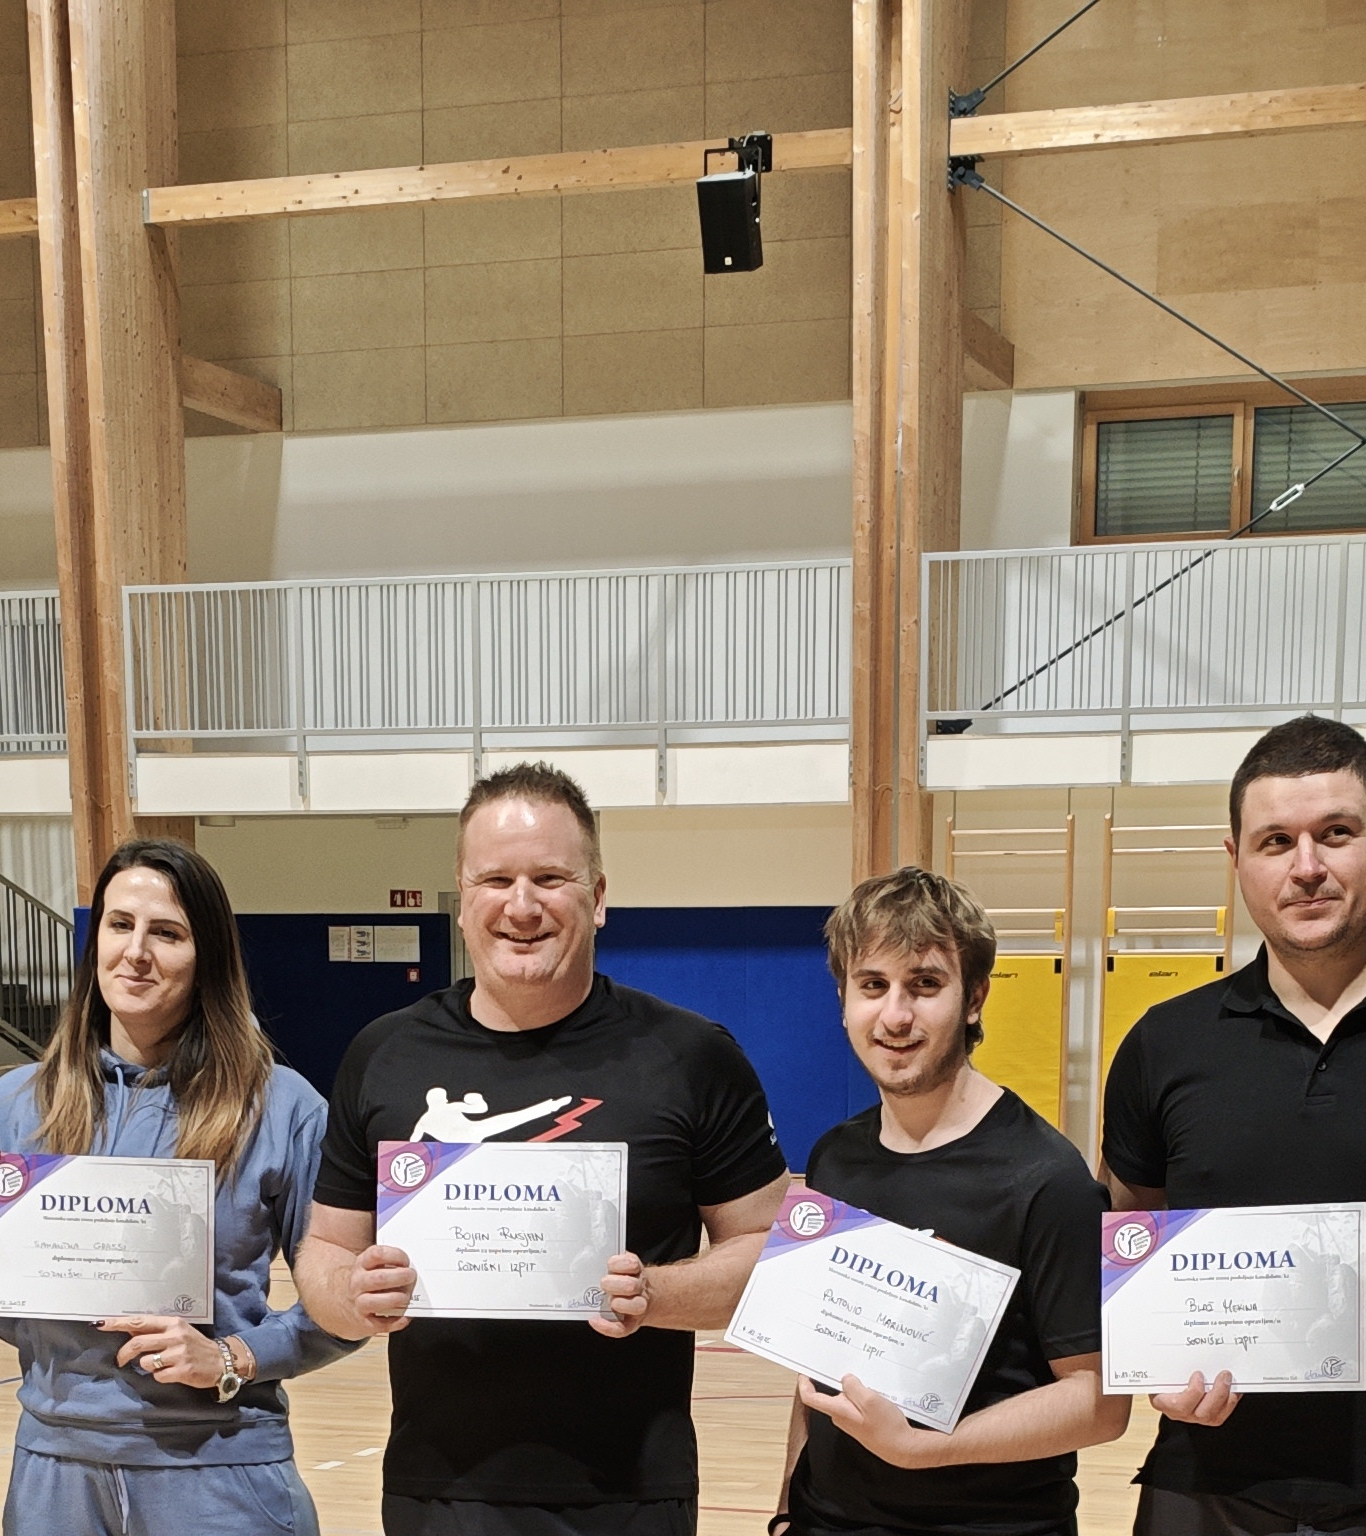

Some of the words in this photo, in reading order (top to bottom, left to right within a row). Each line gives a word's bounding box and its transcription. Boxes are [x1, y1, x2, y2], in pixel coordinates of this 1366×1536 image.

[990, 971, 1019, 979] elan
[443, 1183, 562, 1201] DIPLOMA
[39, 1194, 152, 1214] DIPLOMA
[1170, 1250, 1296, 1272] DIPLOMA
[829, 1245, 939, 1304] DIPLOMA
